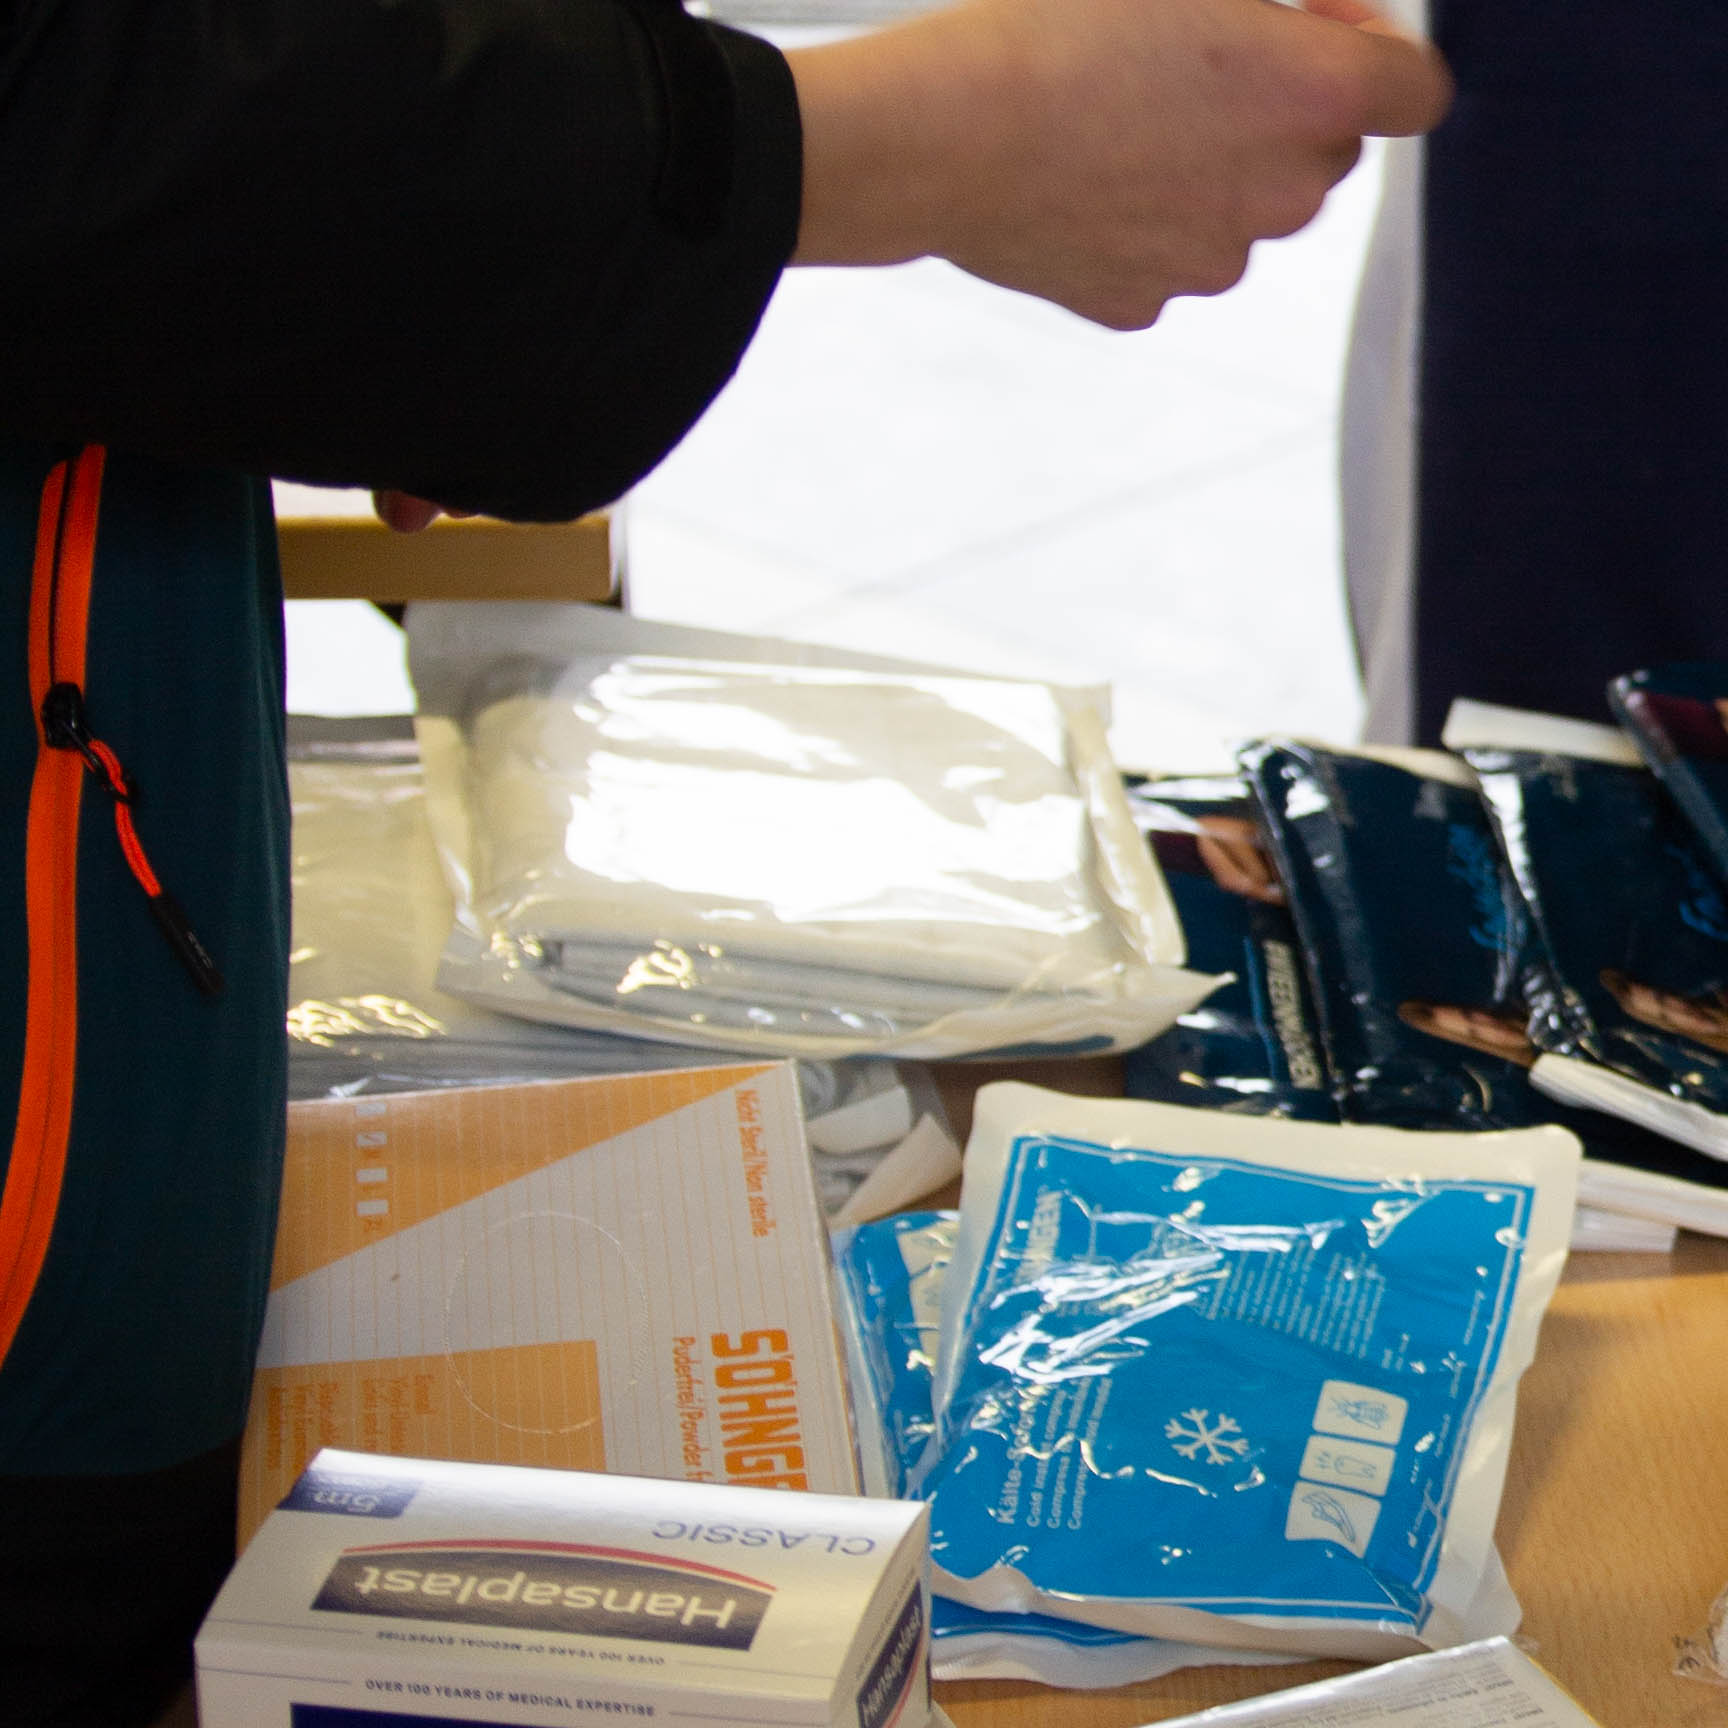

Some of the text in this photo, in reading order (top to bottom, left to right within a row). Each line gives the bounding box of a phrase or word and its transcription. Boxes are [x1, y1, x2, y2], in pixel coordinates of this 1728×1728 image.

[653, 1518, 877, 1557] CLASSIC
[357, 1564, 738, 1629] Hansaplast
[365, 1678, 656, 1717] OVER 100 YEARS OF MEDICAL EXPERTISE
